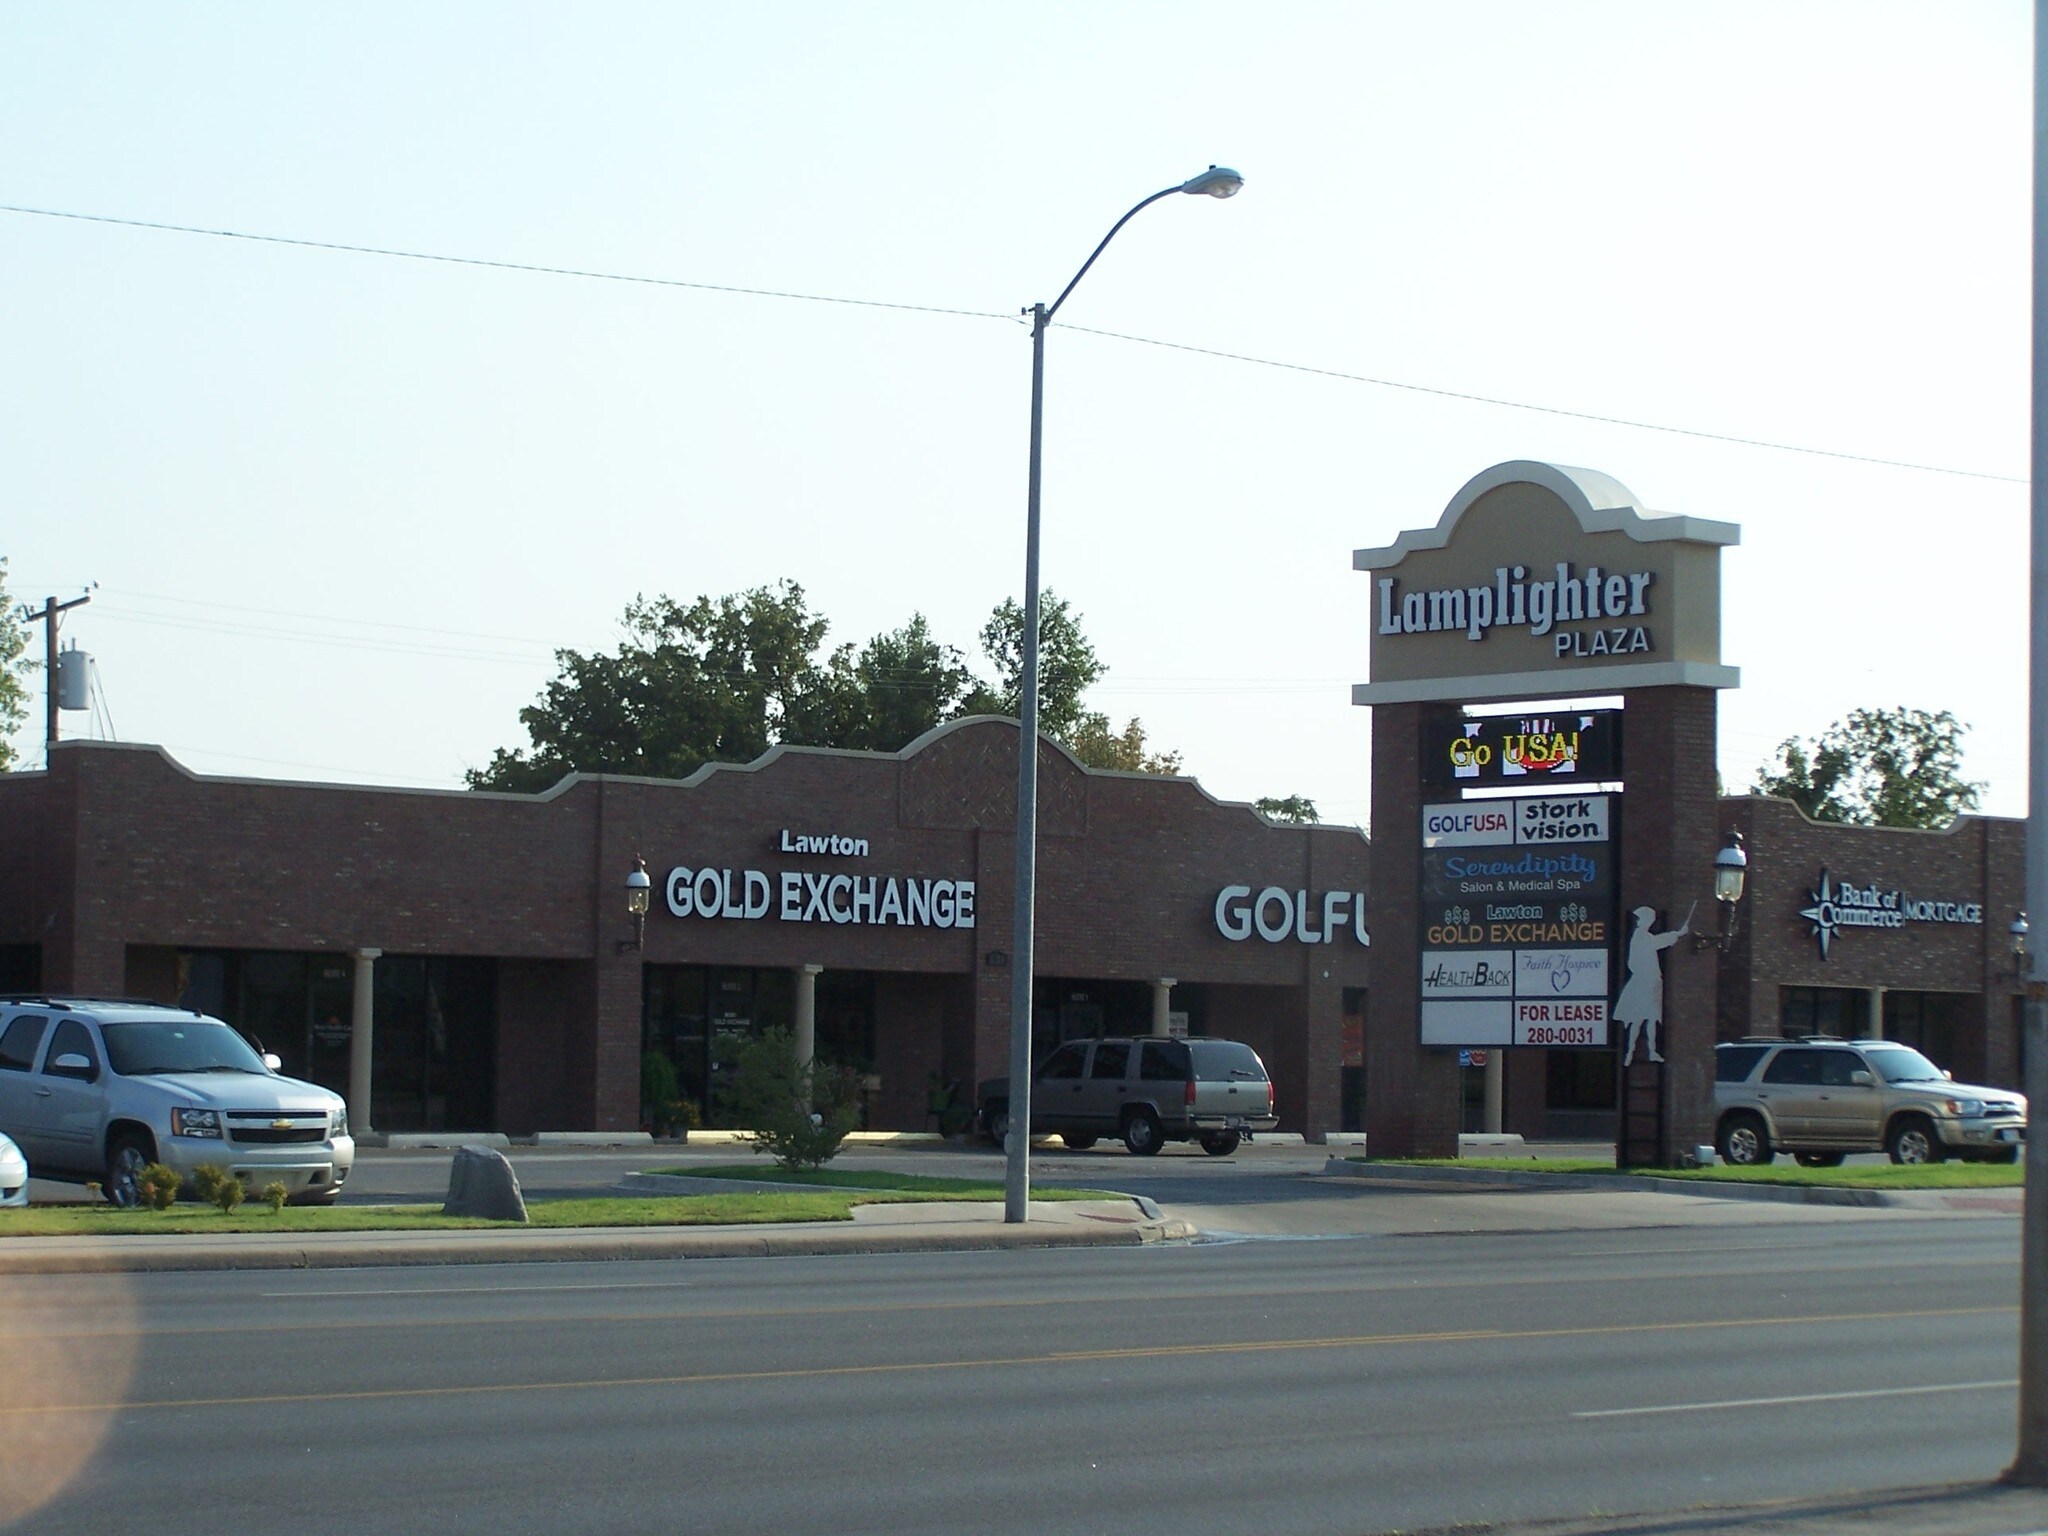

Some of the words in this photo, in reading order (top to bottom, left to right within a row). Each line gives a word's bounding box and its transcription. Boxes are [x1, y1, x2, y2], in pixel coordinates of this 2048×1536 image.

[1378, 562, 1651, 640] Lamplighter
[1554, 626, 1650, 658] PLAZA
[1450, 738, 1492, 766] Go
[1503, 732, 1579, 764] USA!
[1525, 800, 1591, 820] stork
[1521, 821, 1599, 840] vision
[781, 829, 869, 856] Lawton
[1445, 853, 1596, 882] Serendipity
[666, 866, 771, 919] GOLD
[780, 872, 976, 928] EXCHANGE
[1460, 881, 1493, 893] Salon
[1496, 881, 1505, 892] &
[1508, 880, 1554, 891] Medical
[1557, 878, 1581, 892] Spa
[1840, 882, 1882, 908] Bank
[1882, 891, 1899, 909] of
[1487, 904, 1543, 920] Lawton
[1818, 901, 1904, 928] Commerce
[1905, 901, 1983, 924] MORTGAGE
[1428, 925, 1484, 944] GOLD
[1490, 923, 1605, 942] EXCHANGE
[1522, 955, 1552, 971] Faith
[1556, 953, 1602, 972] Hospice
[1520, 1005, 1550, 1021] FOR
[1555, 1005, 1603, 1021] LEASE
[1527, 1027, 1594, 1044] 280-0031
